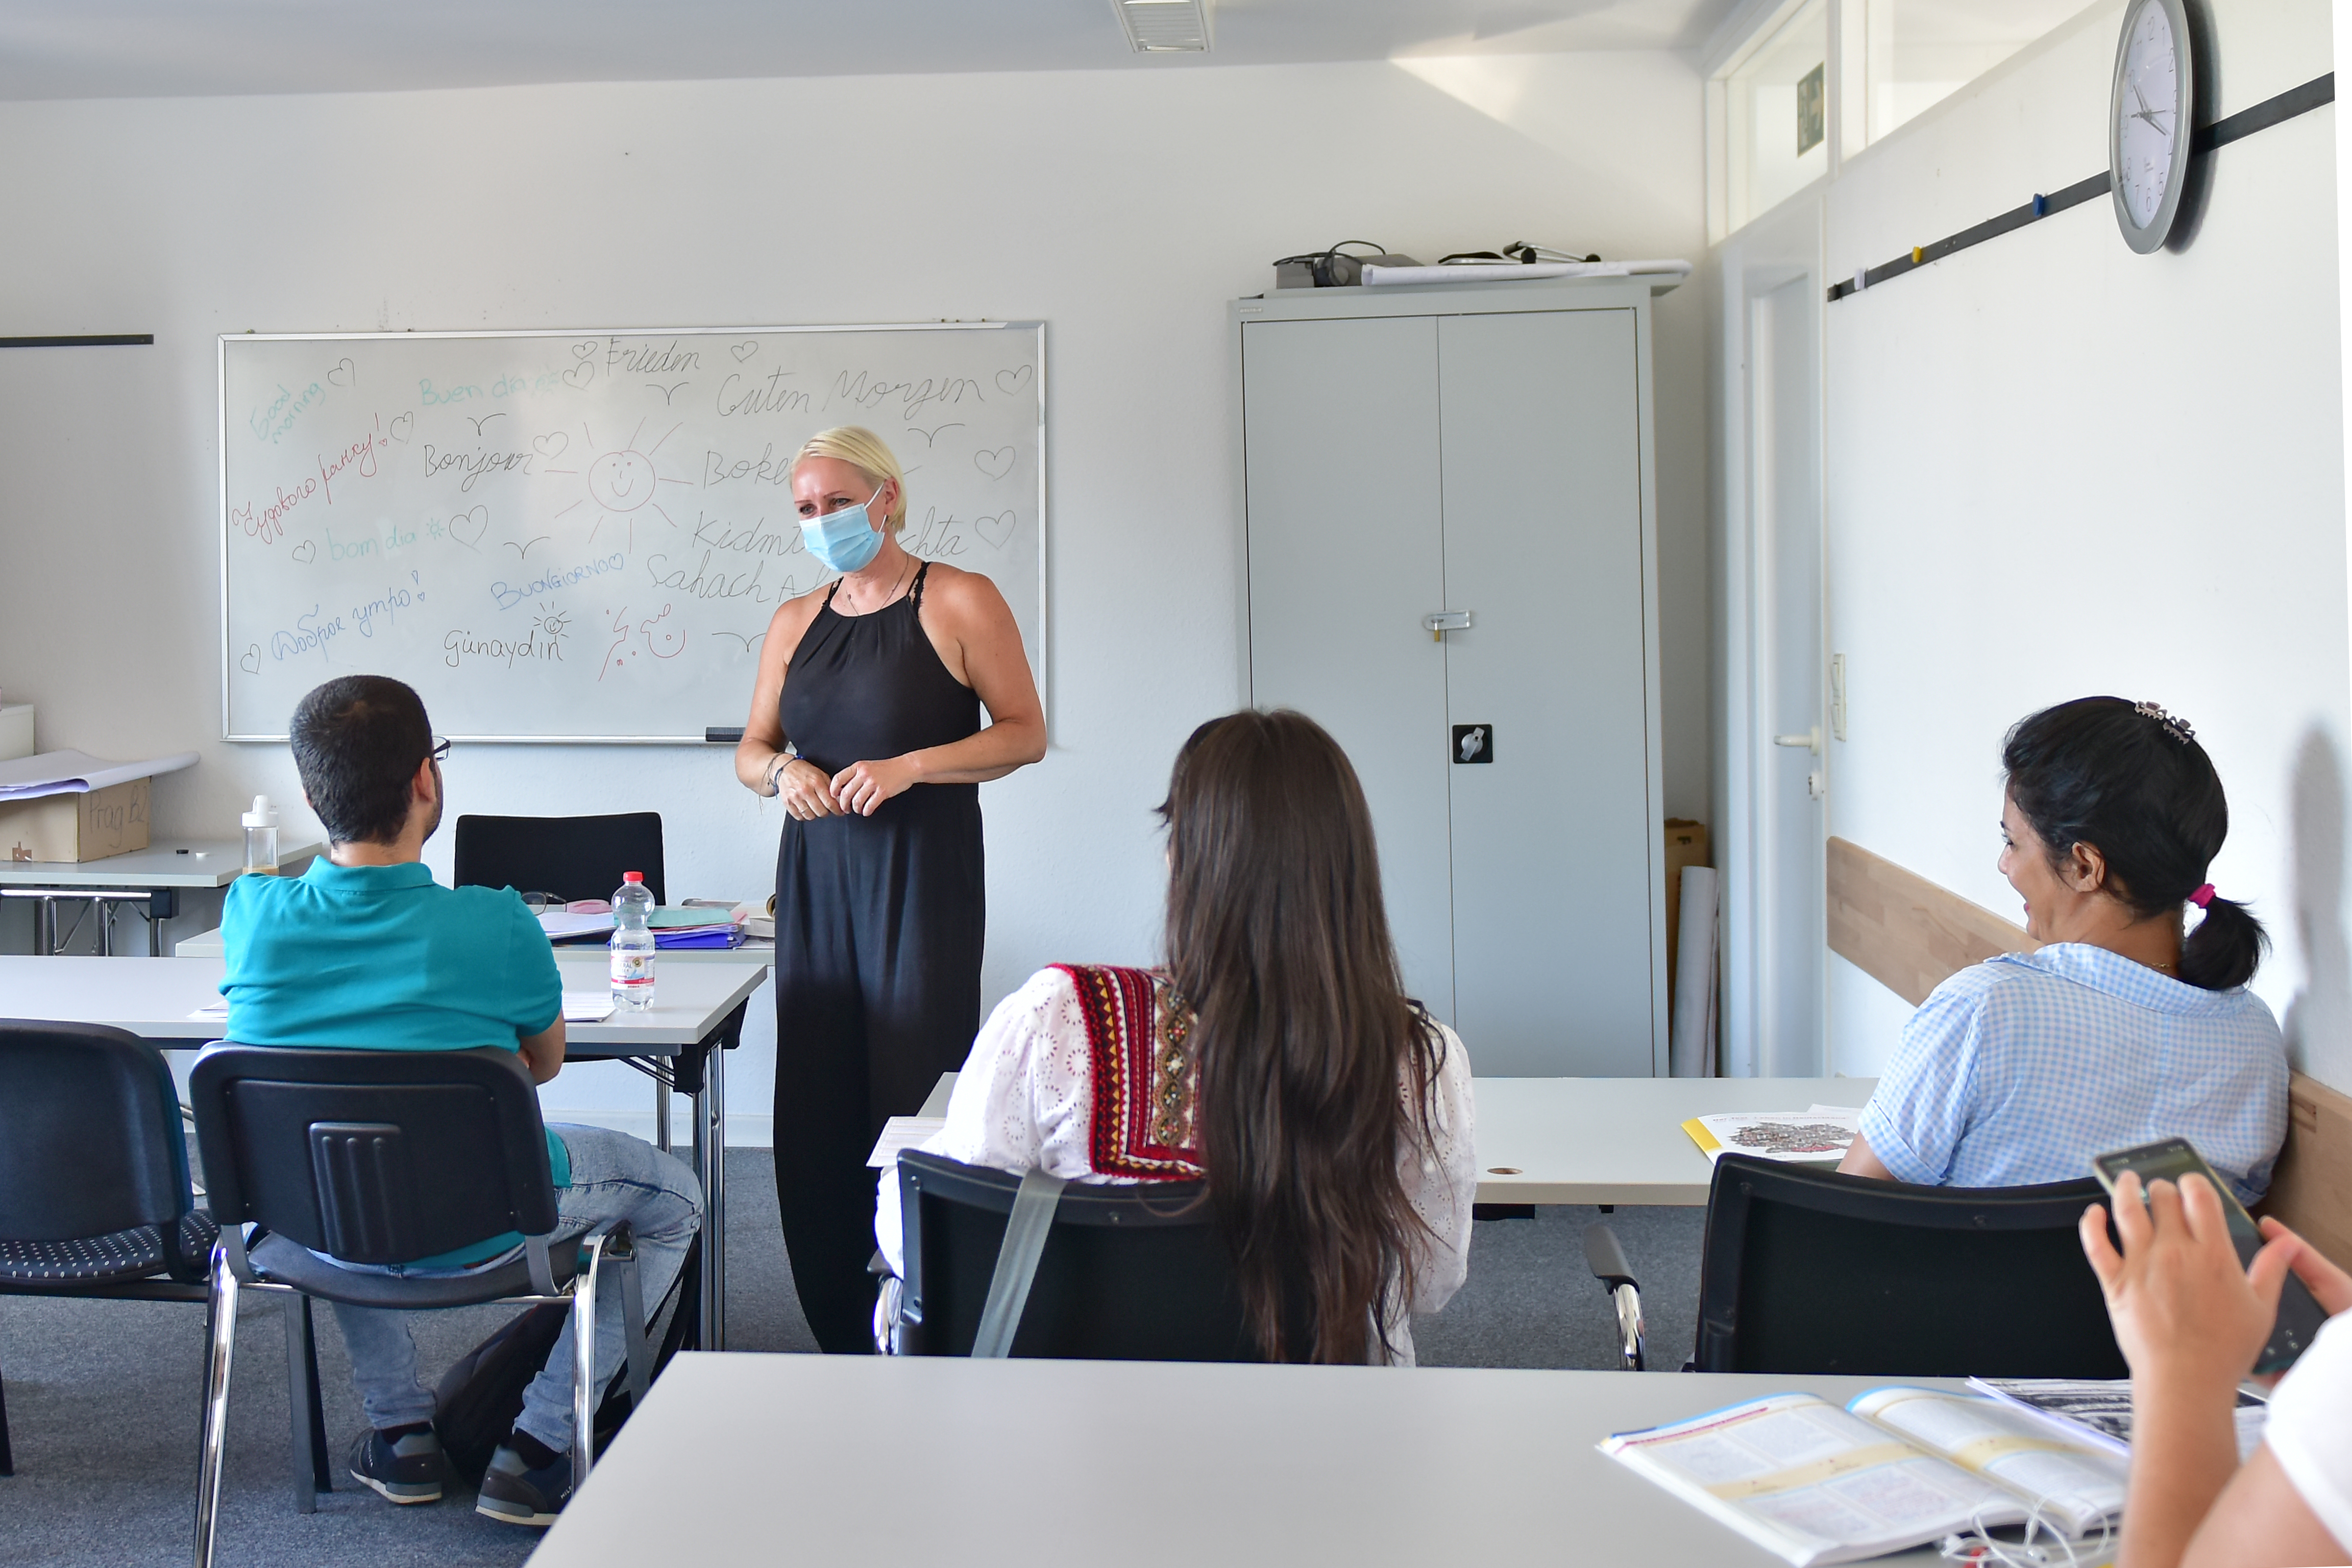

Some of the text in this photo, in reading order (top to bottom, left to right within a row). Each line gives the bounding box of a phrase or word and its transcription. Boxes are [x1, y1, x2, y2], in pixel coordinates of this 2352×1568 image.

[250, 384, 291, 441] Good
[272, 382, 326, 444] morning
[418, 378, 484, 406] Buen
[717, 366, 985, 420] Guten Morgen
[424, 444, 534, 492] Bonjour
[704, 442, 791, 490] Boke
[326, 524, 417, 561] bom dia
[692, 510, 806, 556] Kidmt
